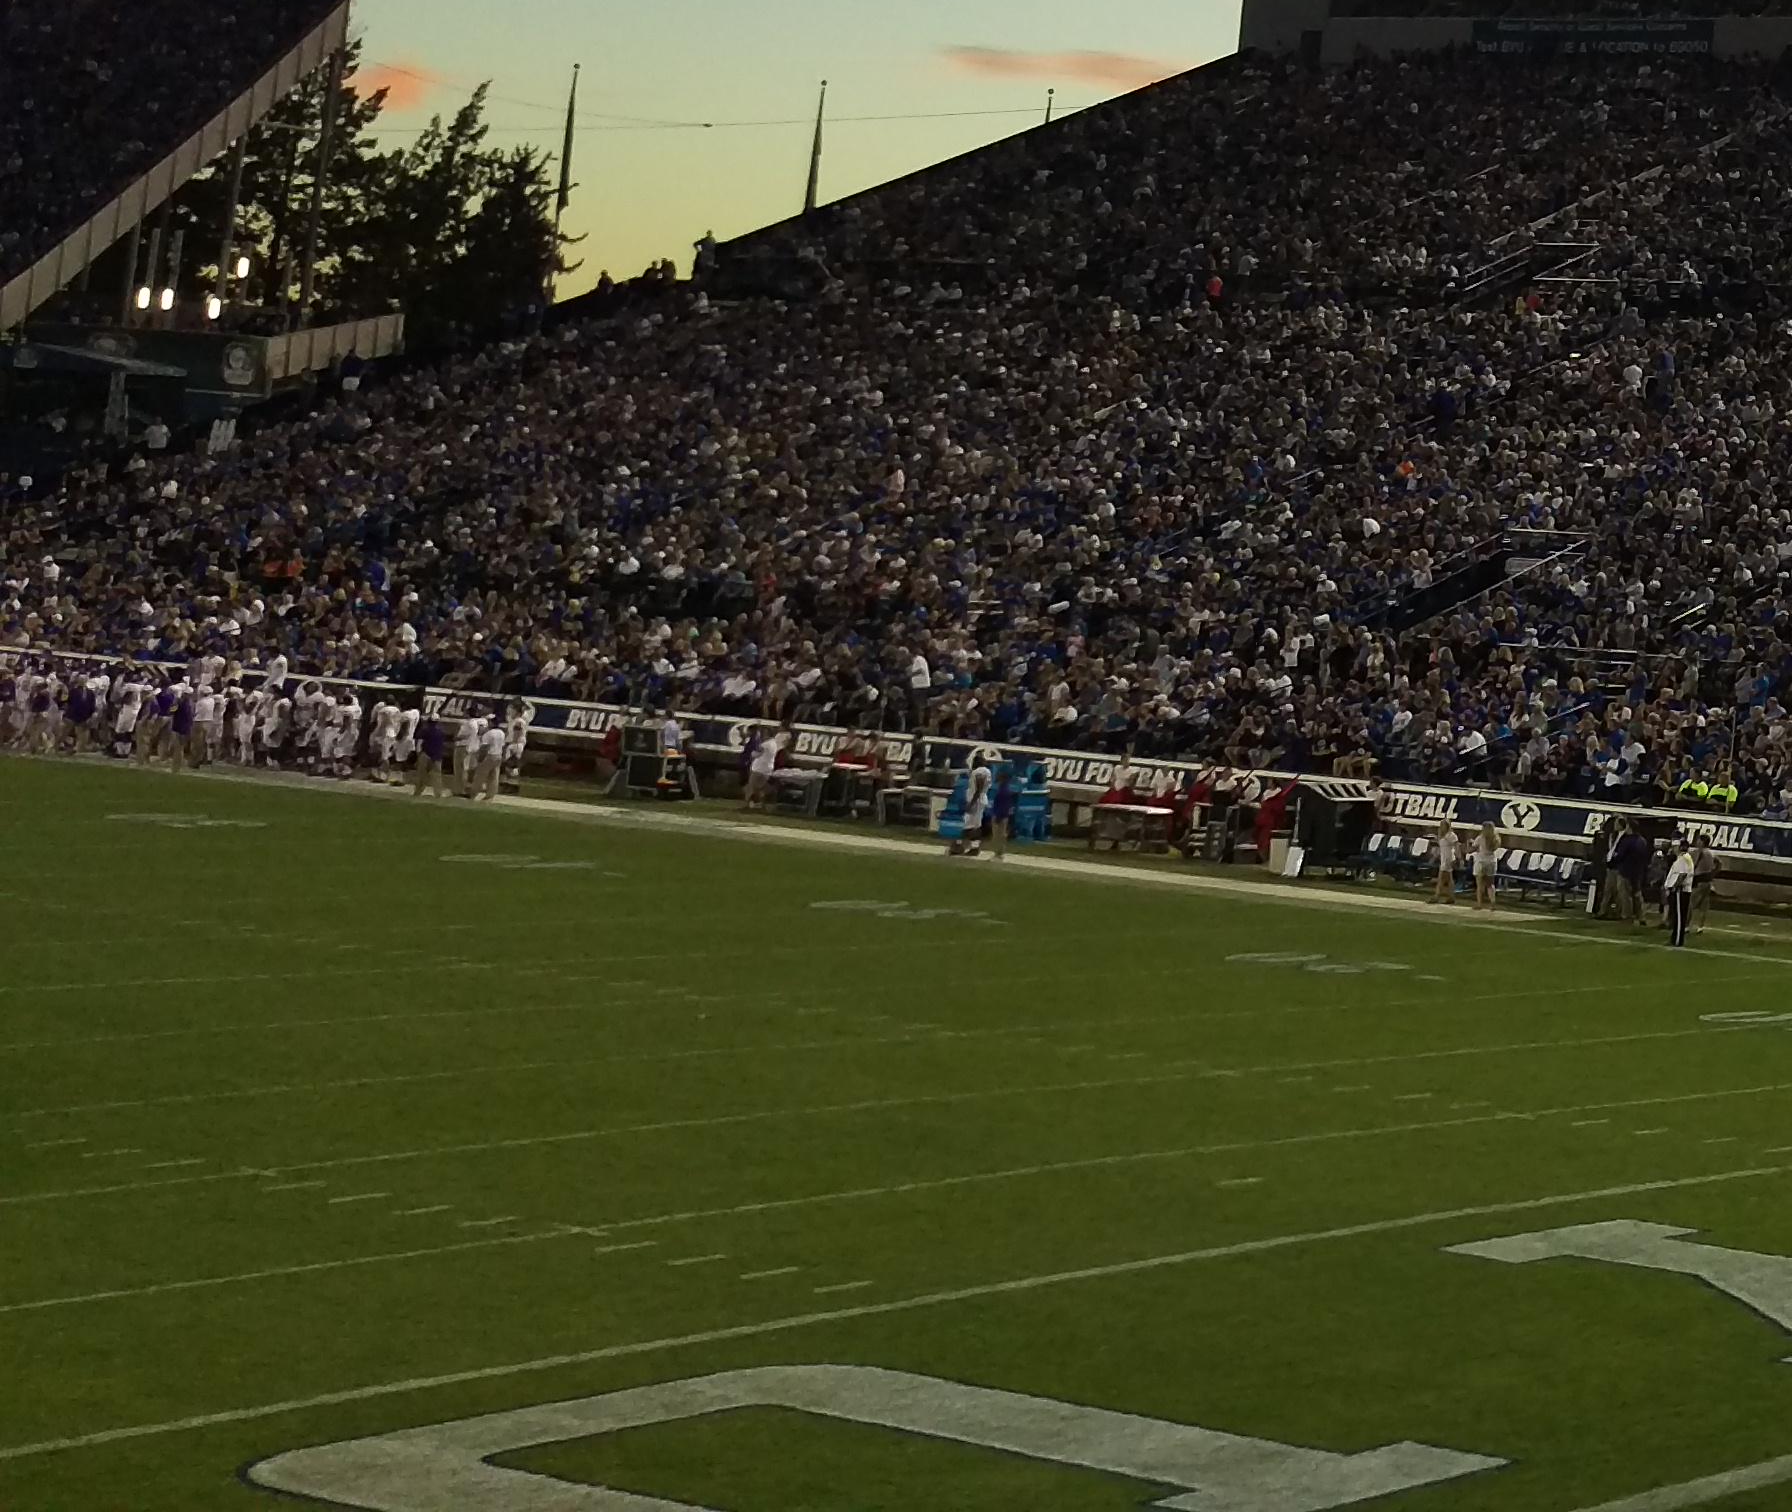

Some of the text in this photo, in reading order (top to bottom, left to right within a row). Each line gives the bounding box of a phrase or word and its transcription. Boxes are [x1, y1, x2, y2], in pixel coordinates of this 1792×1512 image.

[566, 708, 604, 731] BYU
[795, 732, 836, 756] BYU
[1044, 757, 1082, 782] BYU
